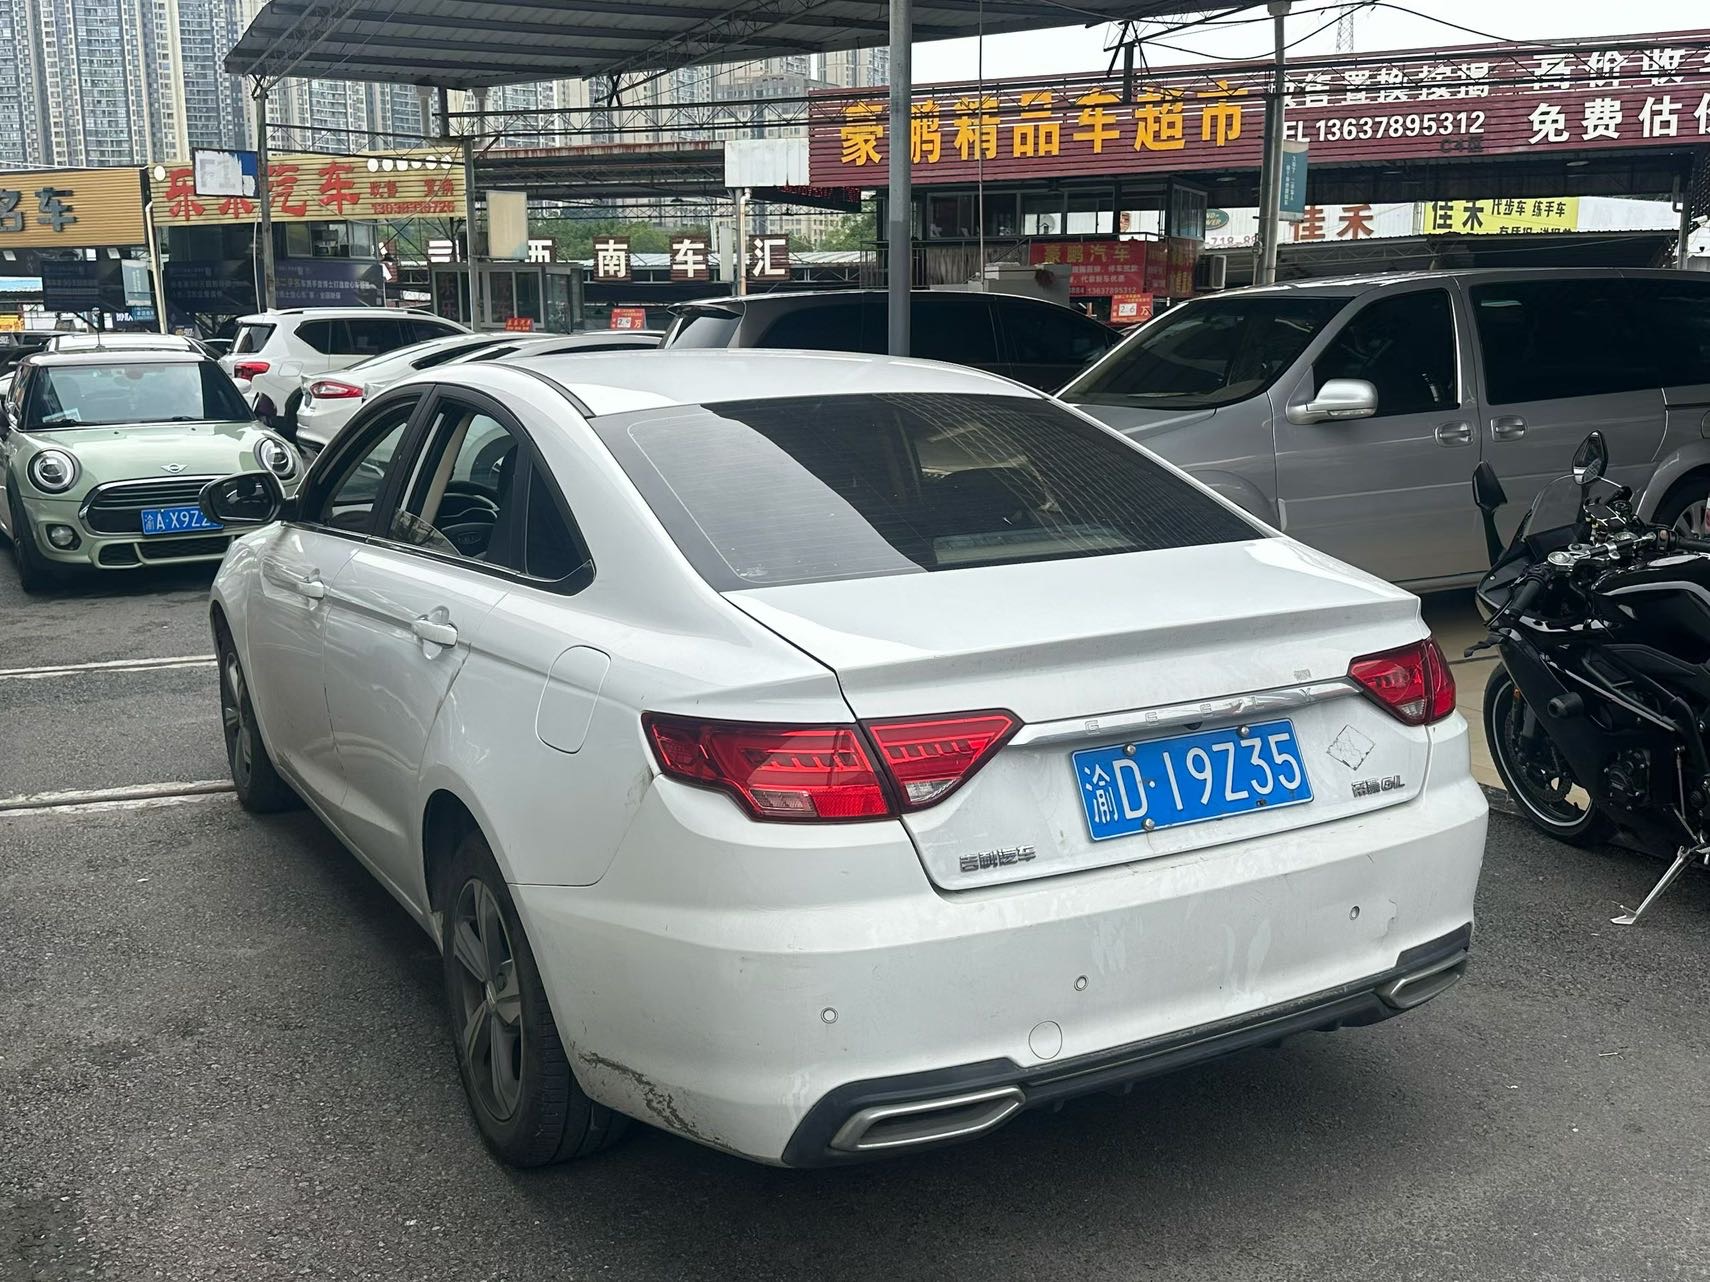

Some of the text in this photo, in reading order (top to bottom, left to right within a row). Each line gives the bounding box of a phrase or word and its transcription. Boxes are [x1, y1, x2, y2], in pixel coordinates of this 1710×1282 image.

[1533, 47, 1710, 89] 高价收
[840, 80, 1249, 166] 豪鹏精品车超市
[1283, 111, 1486, 142] EL 13637895312
[166, 160, 361, 221] 乐汽车
[1491, 199, 1527, 216] 代步车
[1289, 202, 1375, 242] 佳禾
[144, 510, 218, 530] 渝A·X9Z2
[1085, 687, 1315, 735] GEELY
[1084, 732, 1302, 824] 渝D·19Z35
[960, 845, 1036, 873] 吉利汽车
